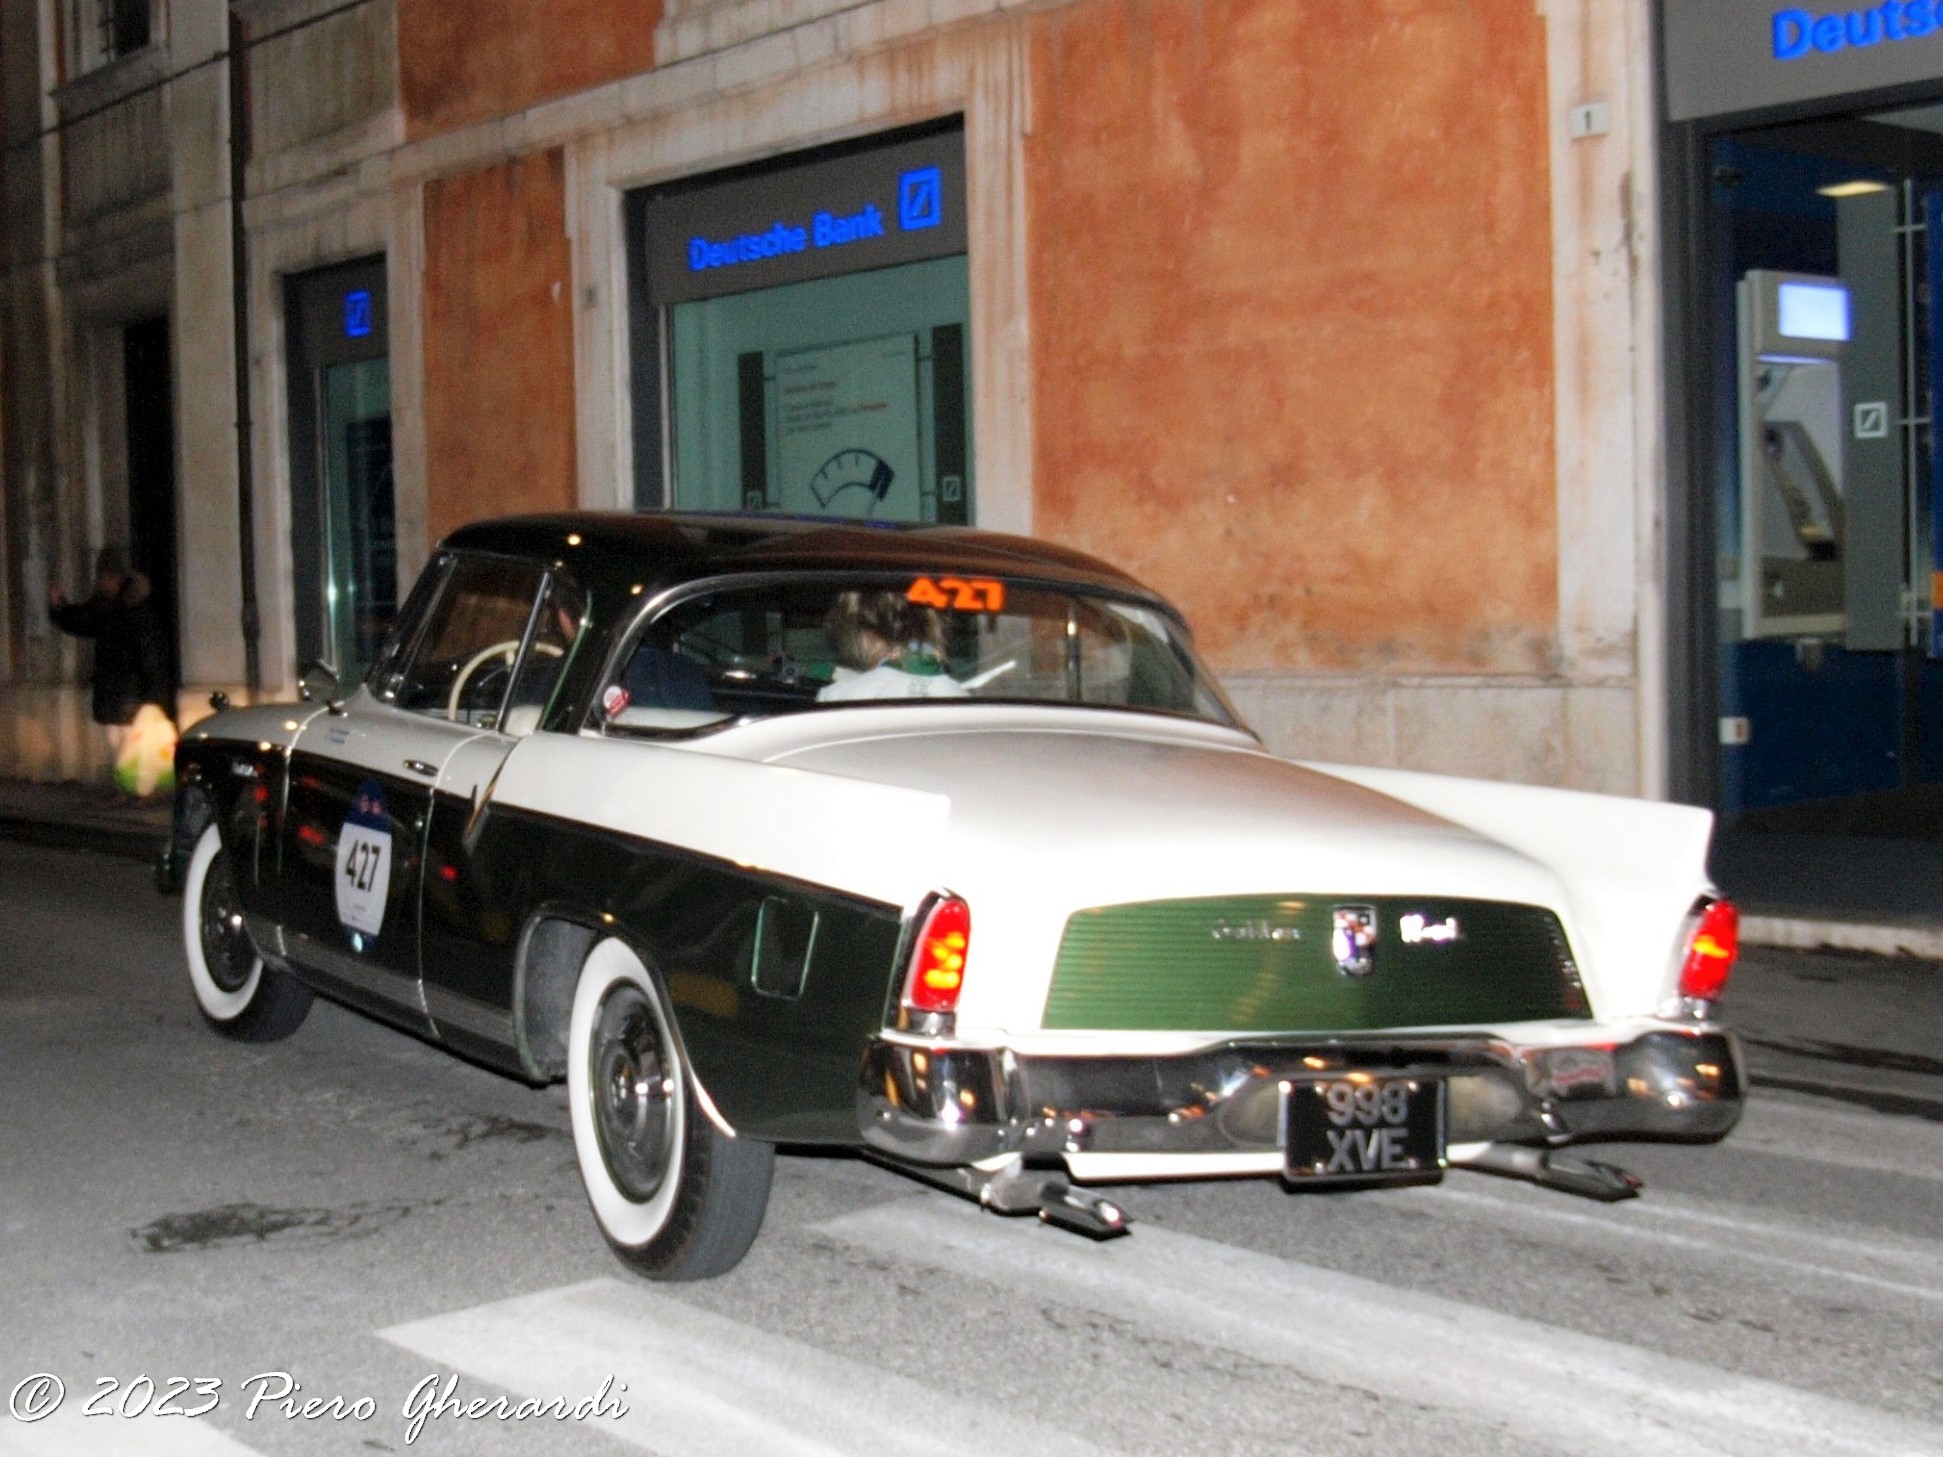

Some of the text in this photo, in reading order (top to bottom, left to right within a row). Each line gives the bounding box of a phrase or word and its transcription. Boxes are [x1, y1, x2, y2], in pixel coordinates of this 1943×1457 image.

[1773, 0, 1943, 61] Deuts
[688, 204, 884, 271] Deutsche Bank
[907, 577, 1004, 612] 427
[345, 839, 382, 893] 427
[1326, 1084, 1408, 1127] 998
[1327, 1127, 1407, 1173] XVE
